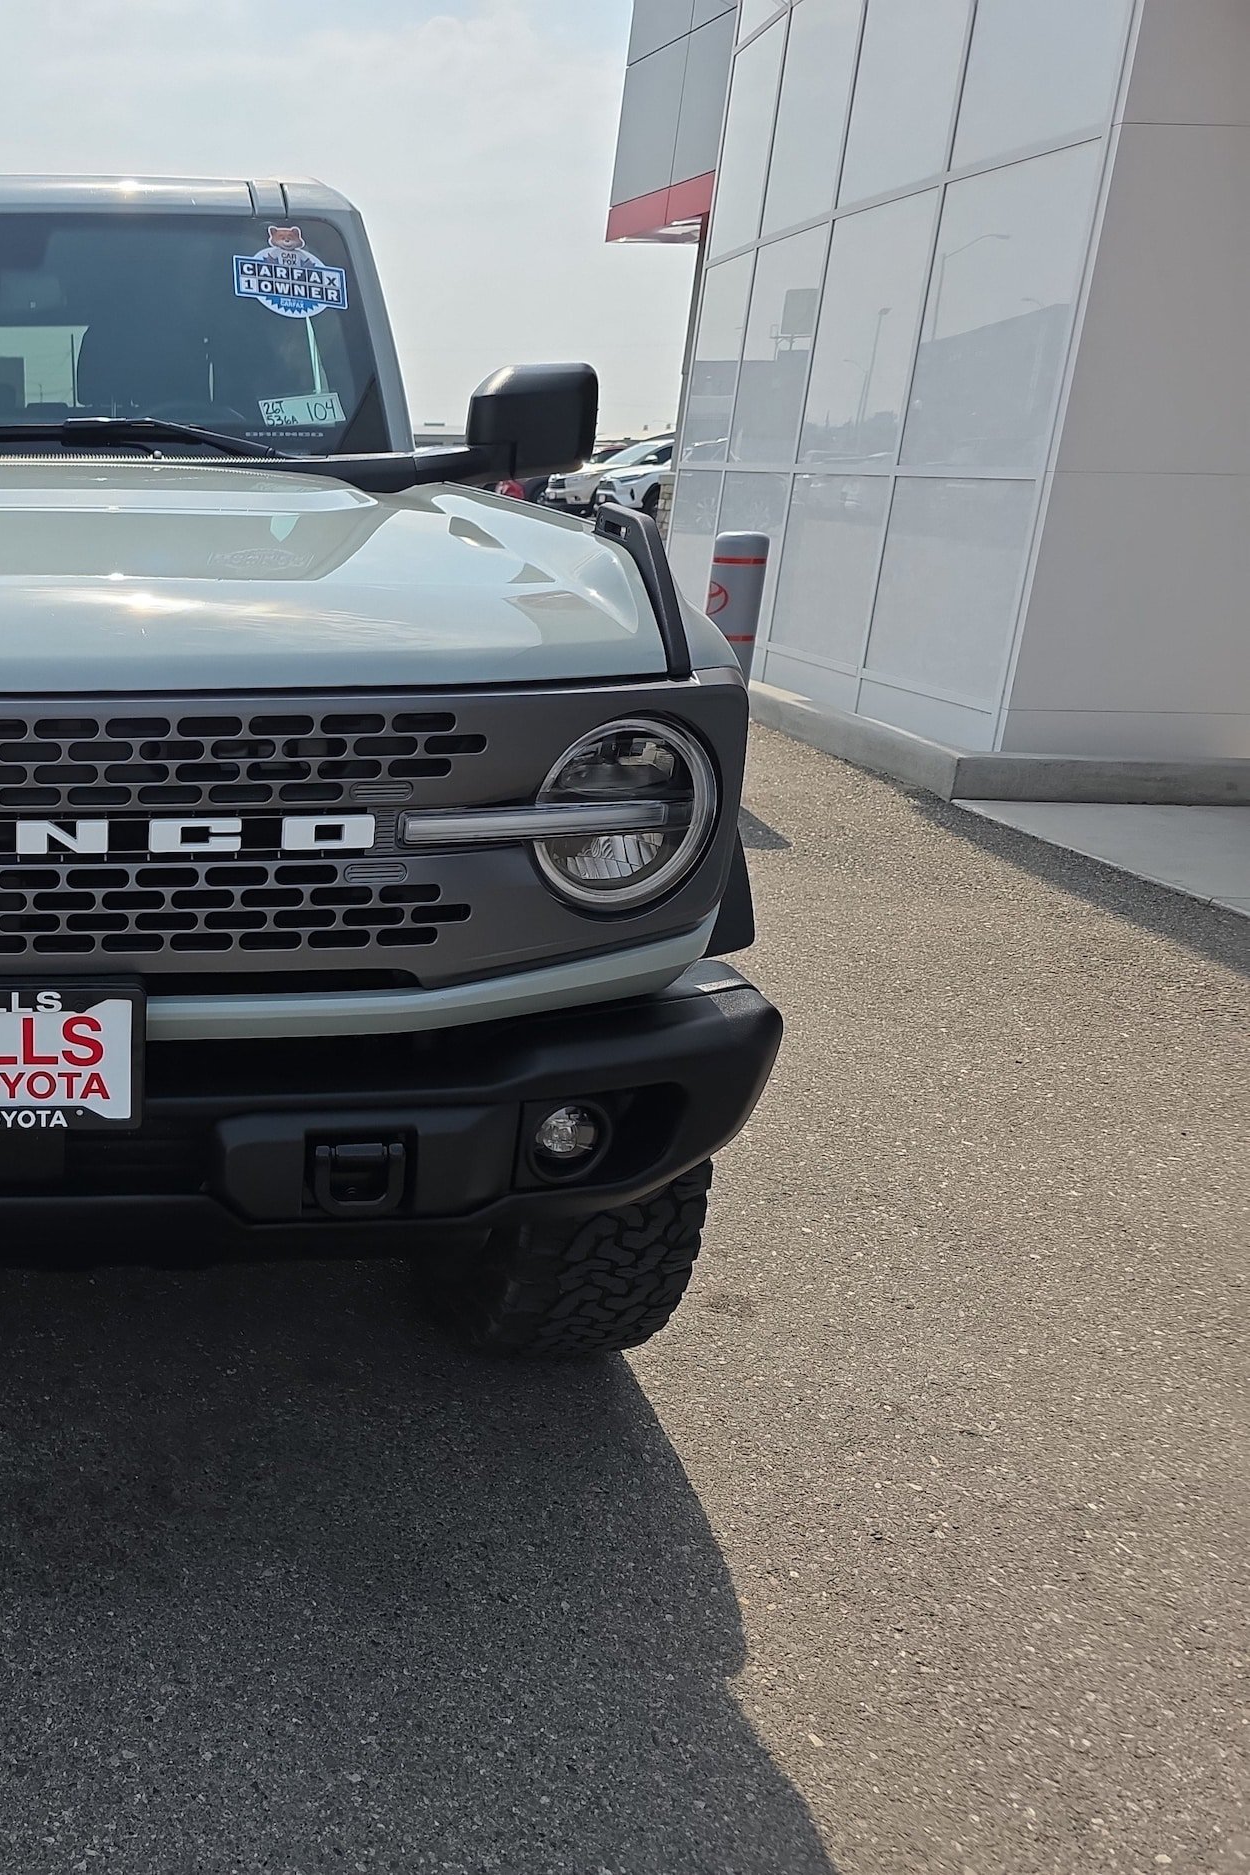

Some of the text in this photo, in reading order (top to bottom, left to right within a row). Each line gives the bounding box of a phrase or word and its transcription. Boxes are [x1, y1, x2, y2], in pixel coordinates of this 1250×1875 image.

[242, 263, 337, 287] CARFAX
[244, 280, 339, 302] 1 OWNER
[306, 399, 337, 422] 104
